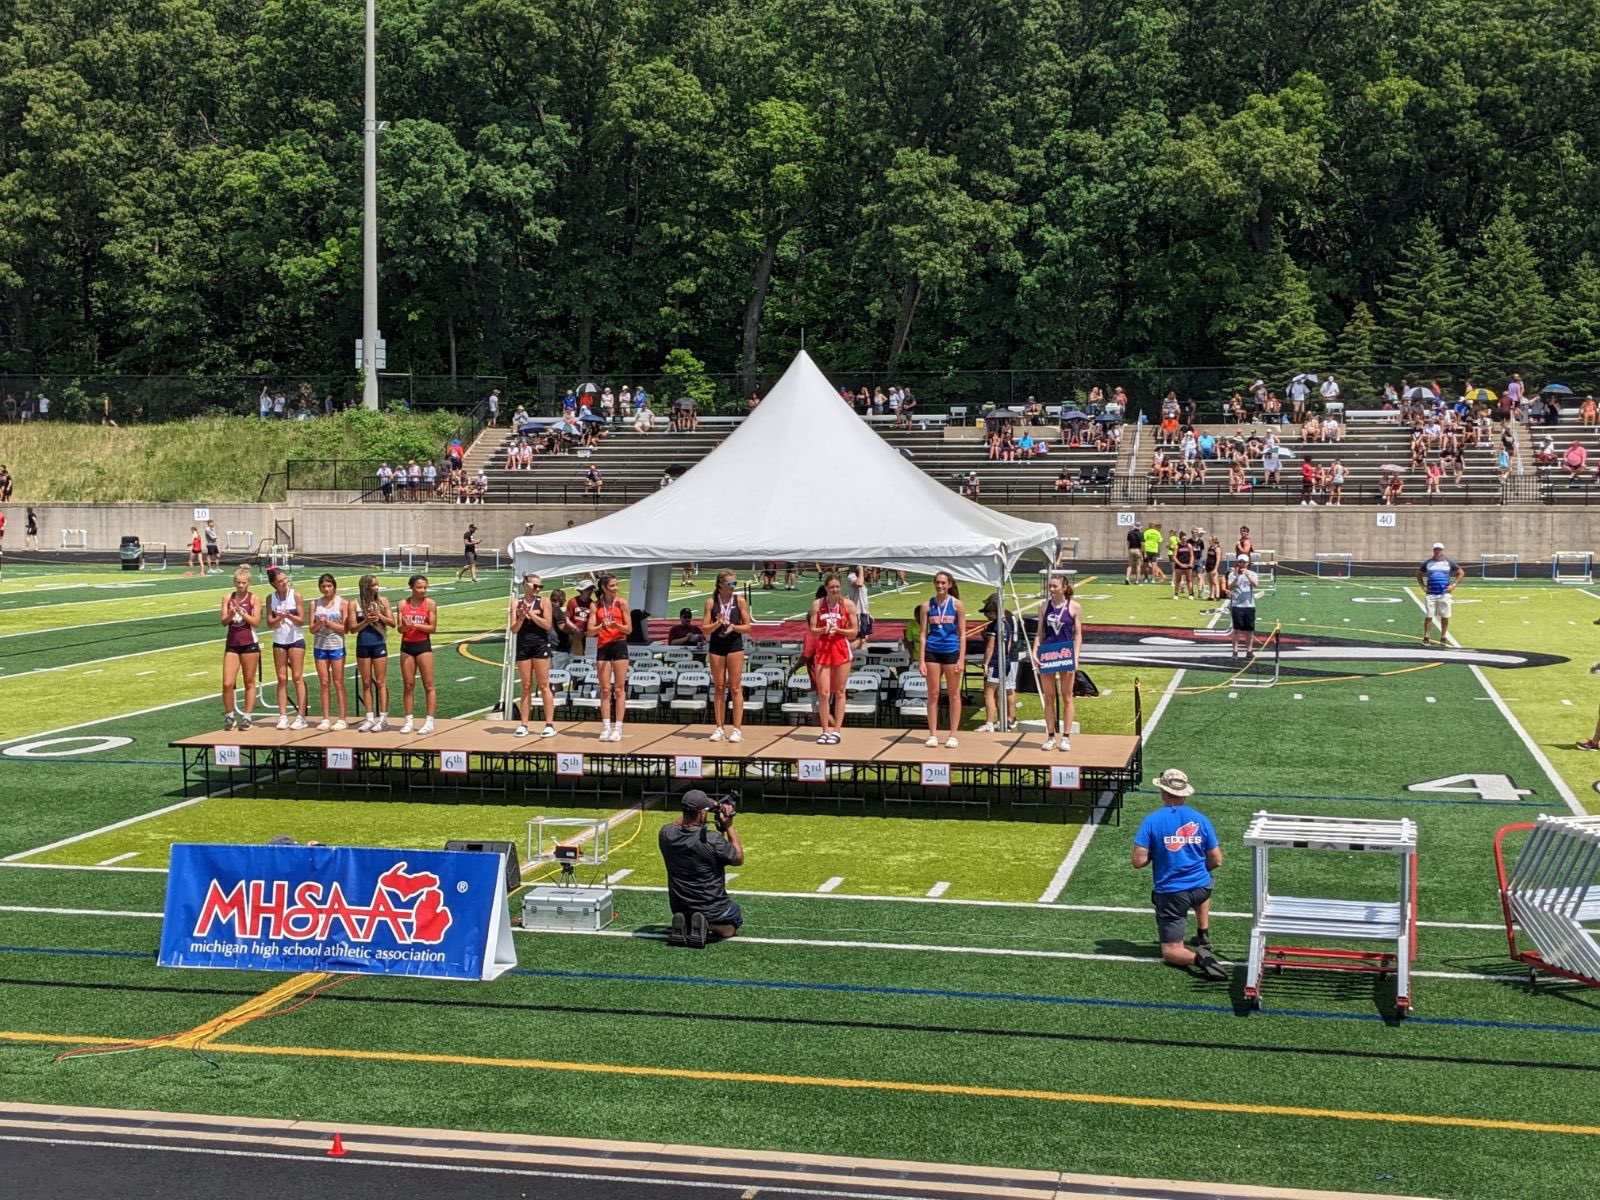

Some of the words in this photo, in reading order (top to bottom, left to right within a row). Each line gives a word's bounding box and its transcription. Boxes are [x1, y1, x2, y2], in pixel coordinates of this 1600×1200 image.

[196, 510, 207, 519] 10
[1120, 513, 1133, 524] 50
[1379, 514, 1393, 525] 40
[219, 749, 236, 764] 8th
[331, 752, 348, 767] 7th
[445, 755, 462, 769] 6th
[561, 757, 579, 772] 5th
[679, 759, 697, 774] 4th
[802, 763, 821, 778] 3rd
[925, 767, 946, 782] 2nd
[1059, 771, 1075, 785] 1st
[1407, 773, 1532, 801] 4
[1163, 835, 1202, 844] EDDIES
[193, 878, 413, 944] MHSAA
[190, 940, 248, 957] michigan
[251, 941, 279, 958] high
[282, 942, 322, 956] school
[323, 943, 372, 959] athletic
[375, 948, 446, 962] association
